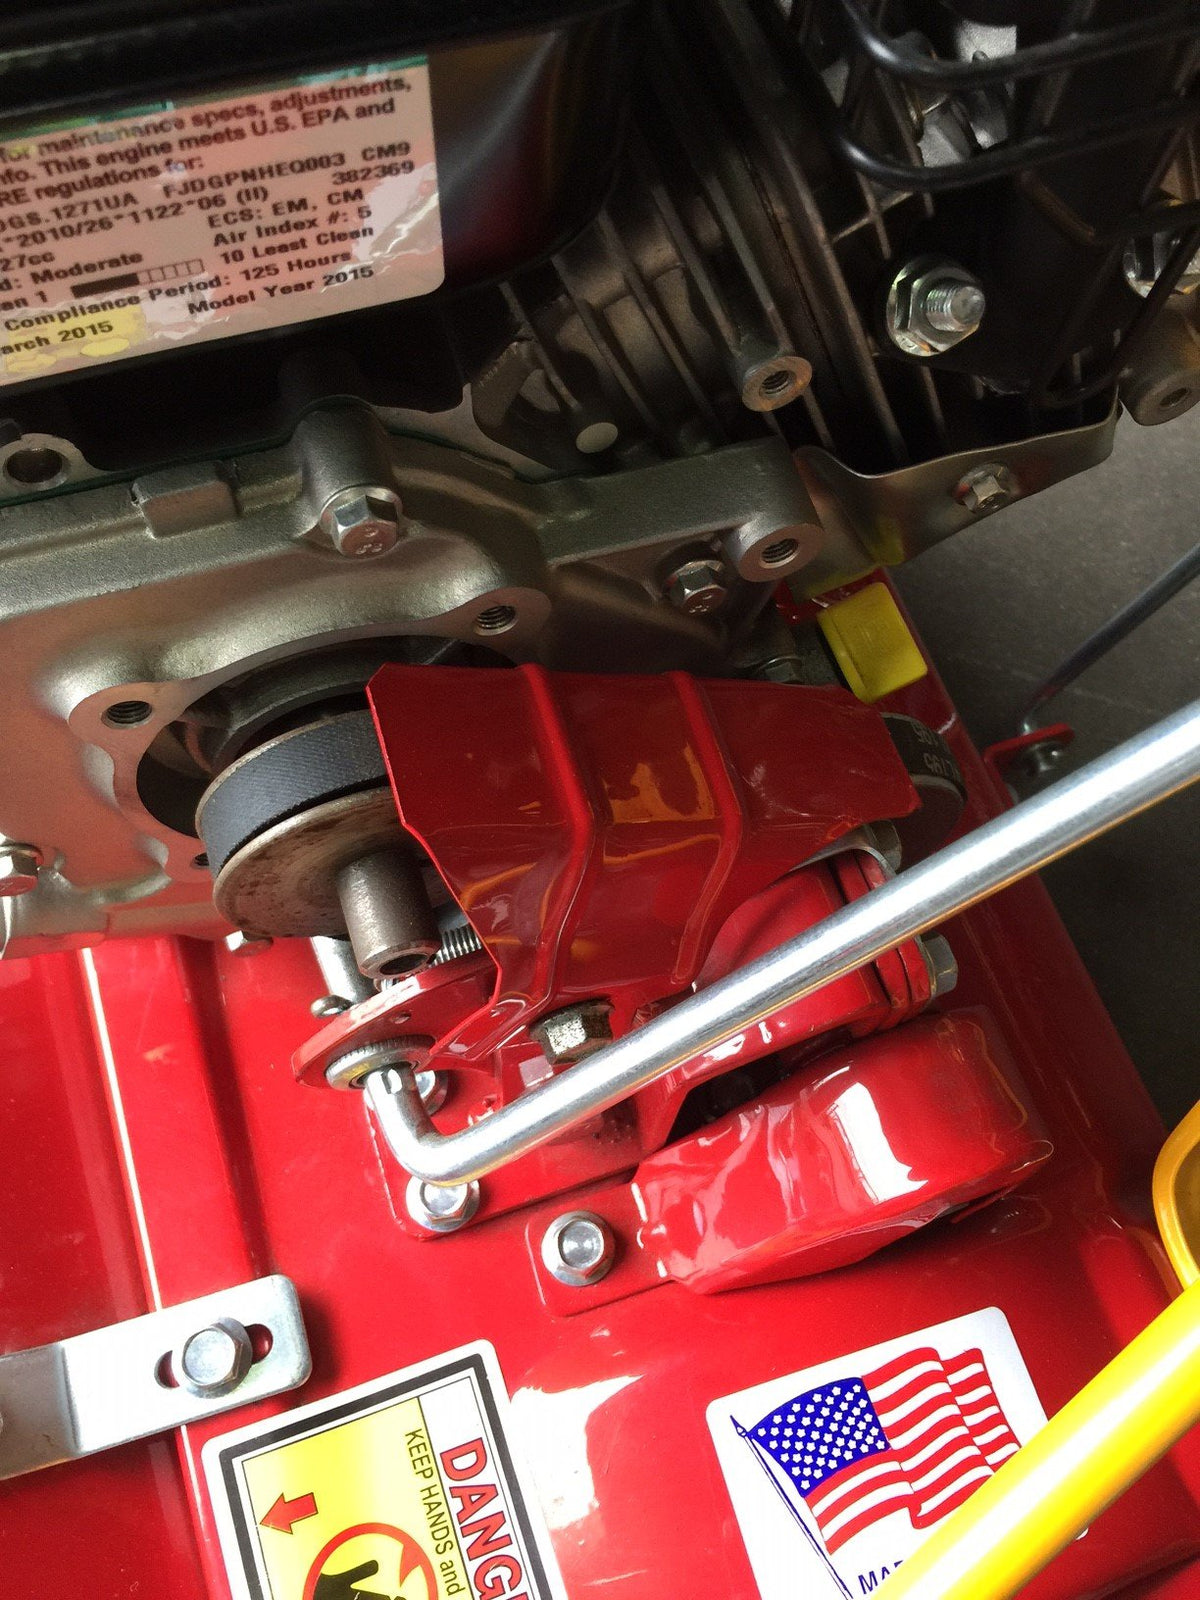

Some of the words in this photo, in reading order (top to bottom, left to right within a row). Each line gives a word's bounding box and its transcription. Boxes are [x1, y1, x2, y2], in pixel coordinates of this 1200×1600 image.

[37, 156, 91, 177] This
[96, 141, 172, 166] engine
[178, 127, 246, 151] meets
[251, 115, 297, 137] U.S.
[302, 105, 350, 129] EPA
[355, 98, 395, 119] and
[38, 117, 185, 156] maintenance
[192, 103, 264, 128] specs,
[270, 76, 412, 112] adjustments,
[34, 164, 161, 200] regulations
[165, 156, 204, 173] for:
[332, 159, 415, 185] 382369
[207, 207, 263, 229] ECS:
[327, 188, 364, 206] CM
[30, 252, 144, 284] Moderate
[213, 230, 247, 247] Air
[255, 217, 319, 238] Index
[327, 211, 348, 225] #:
[357, 205, 373, 220] 5
[34, 290, 48, 303] 1
[220, 249, 245, 265] 10
[252, 237, 308, 259] Least
[316, 226, 374, 246] Clean
[4, 294, 141, 332] Compliance
[148, 274, 231, 302] Period:
[239, 263, 280, 281] 125
[287, 250, 352, 272] Hours
[187, 290, 256, 315] Model
[263, 280, 315, 298] Year
[322, 265, 374, 287] 2015
[57, 320, 113, 342] 2015
[405, 1428, 434, 1480] KEEP
[419, 1483, 454, 1555] HANDS
[440, 1437, 529, 1600] DANG
[439, 1560, 466, 1596] and
